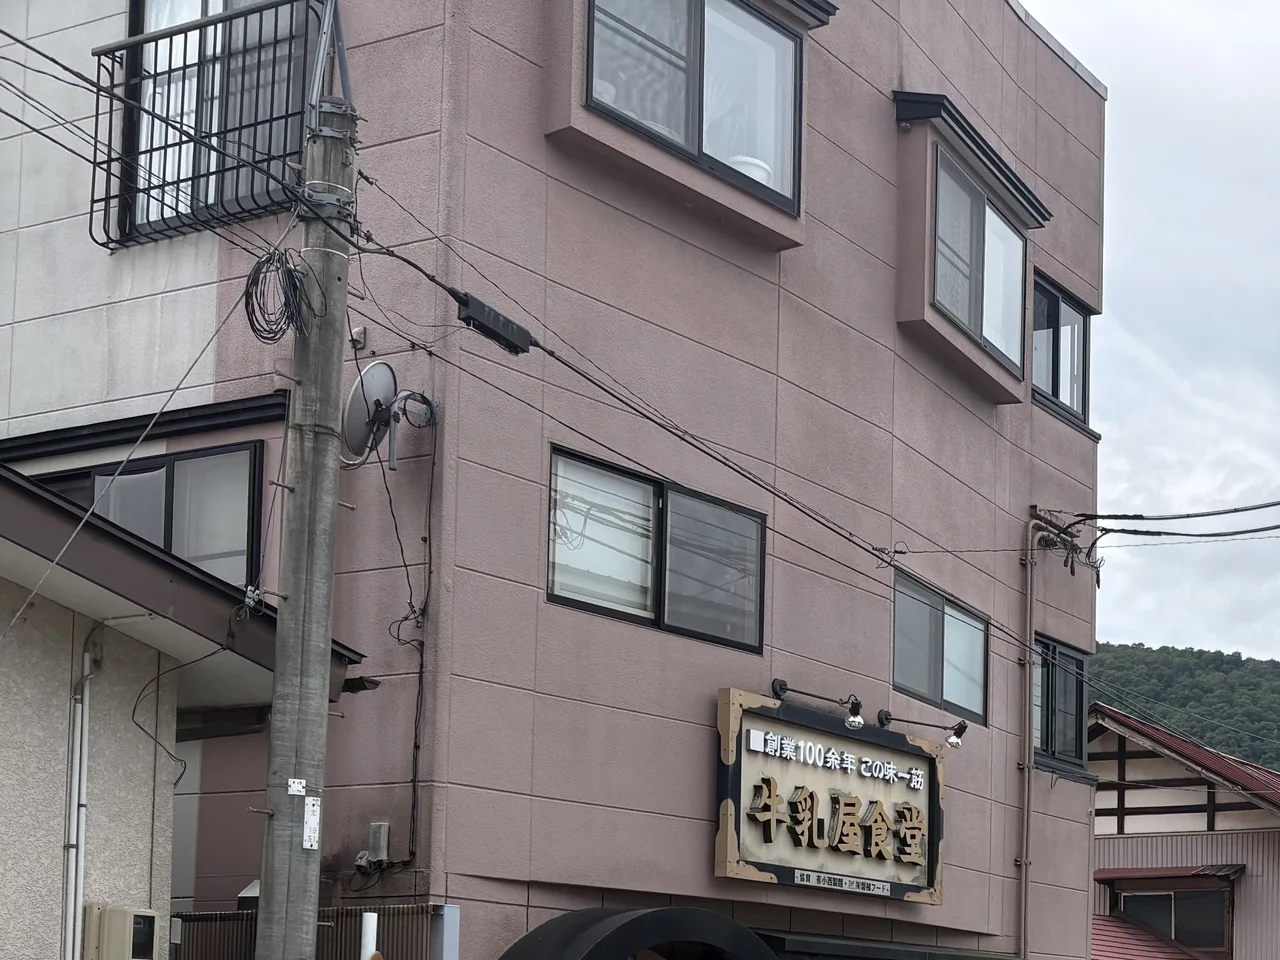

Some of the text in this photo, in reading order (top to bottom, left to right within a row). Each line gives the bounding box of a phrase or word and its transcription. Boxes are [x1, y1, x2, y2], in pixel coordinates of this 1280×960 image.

[747, 777, 926, 866] 牛乳屋食堂
